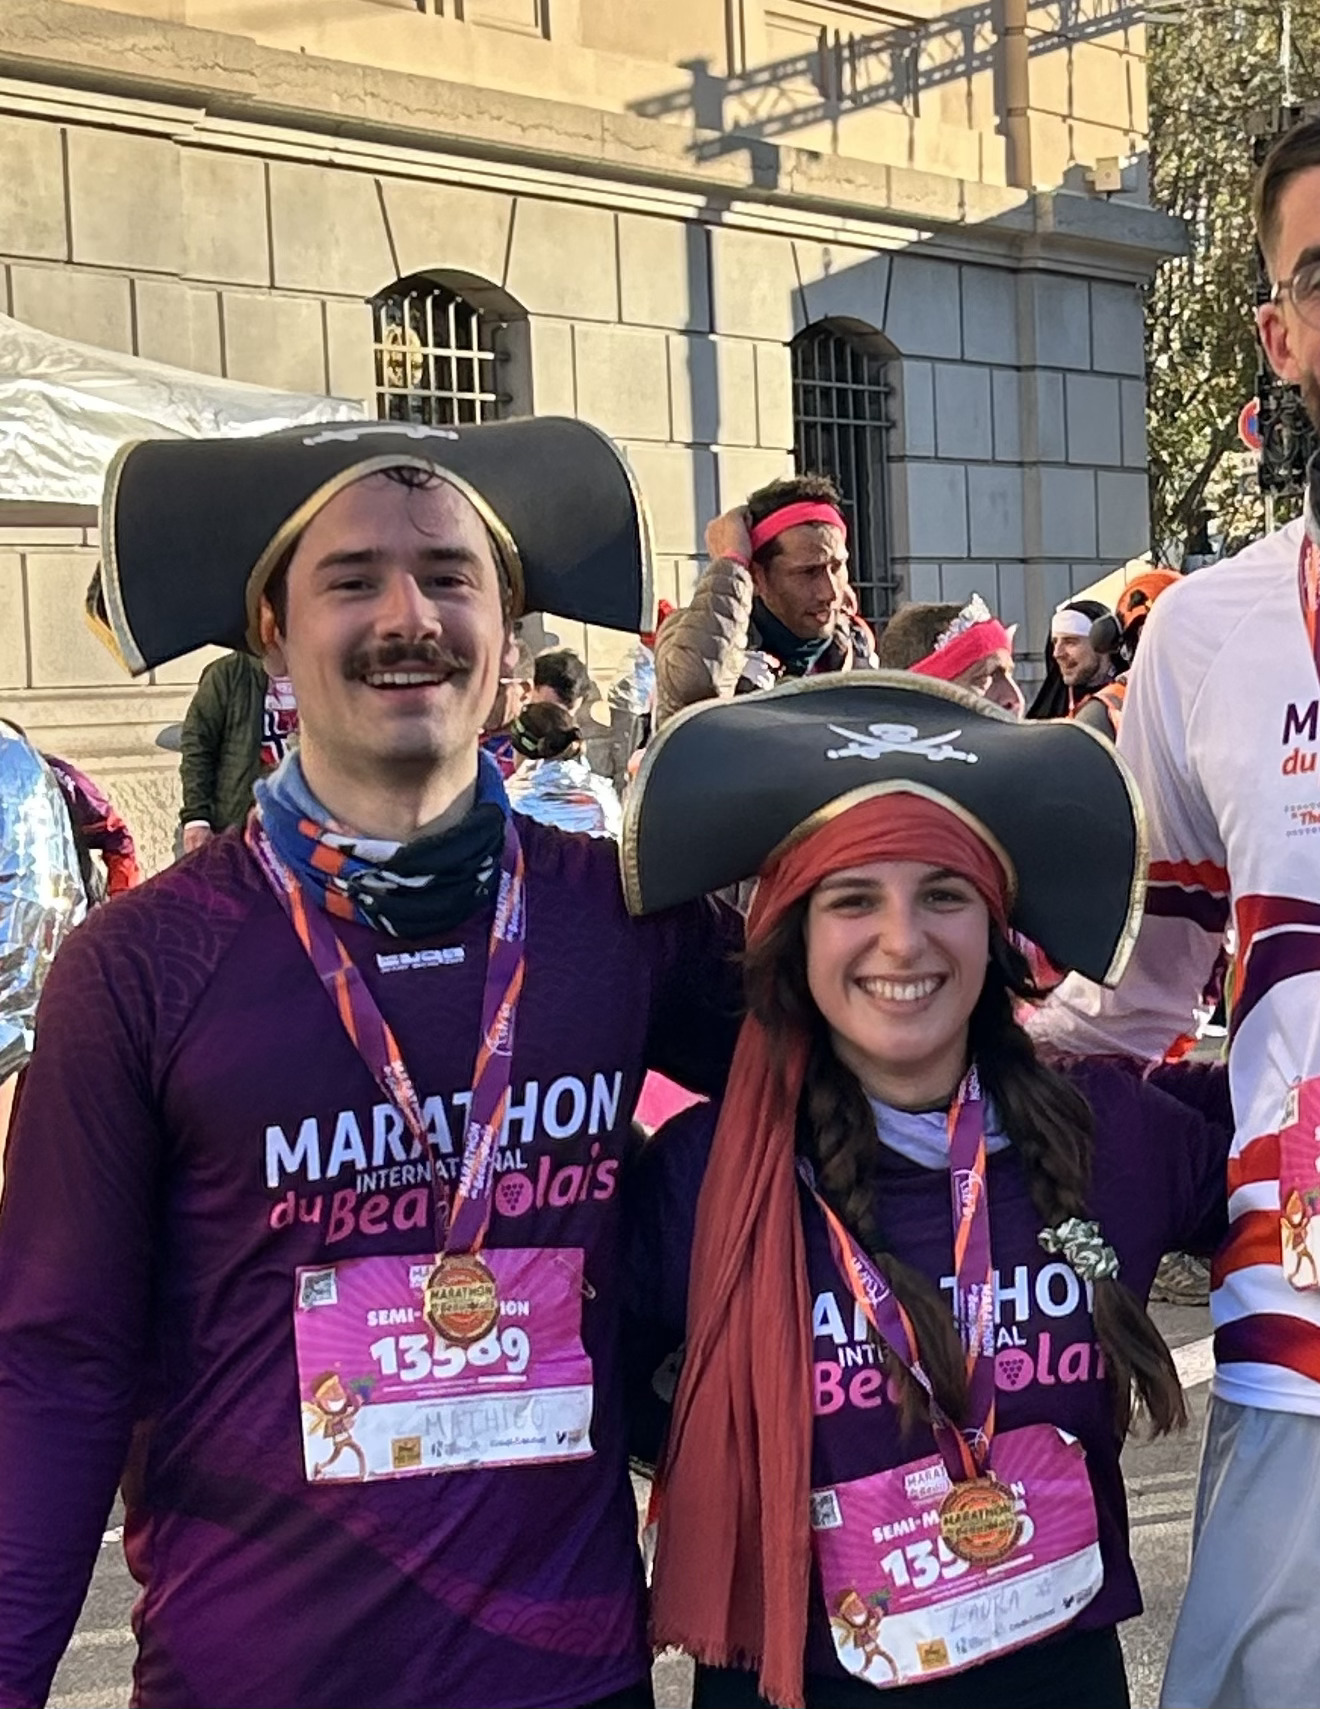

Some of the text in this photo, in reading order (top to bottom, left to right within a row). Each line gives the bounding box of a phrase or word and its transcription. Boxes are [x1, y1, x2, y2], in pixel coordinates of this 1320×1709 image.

[1281, 748, 1317, 776] du
[269, 1191, 322, 1230] du
[325, 1141, 620, 1246] Beaolais
[356, 1147, 528, 1194] INTERNATNAL
[367, 1300, 530, 1327] SEMI-ON
[872, 1481, 1026, 1544] SEMI-MN
[880, 1514, 1034, 1589] 135
